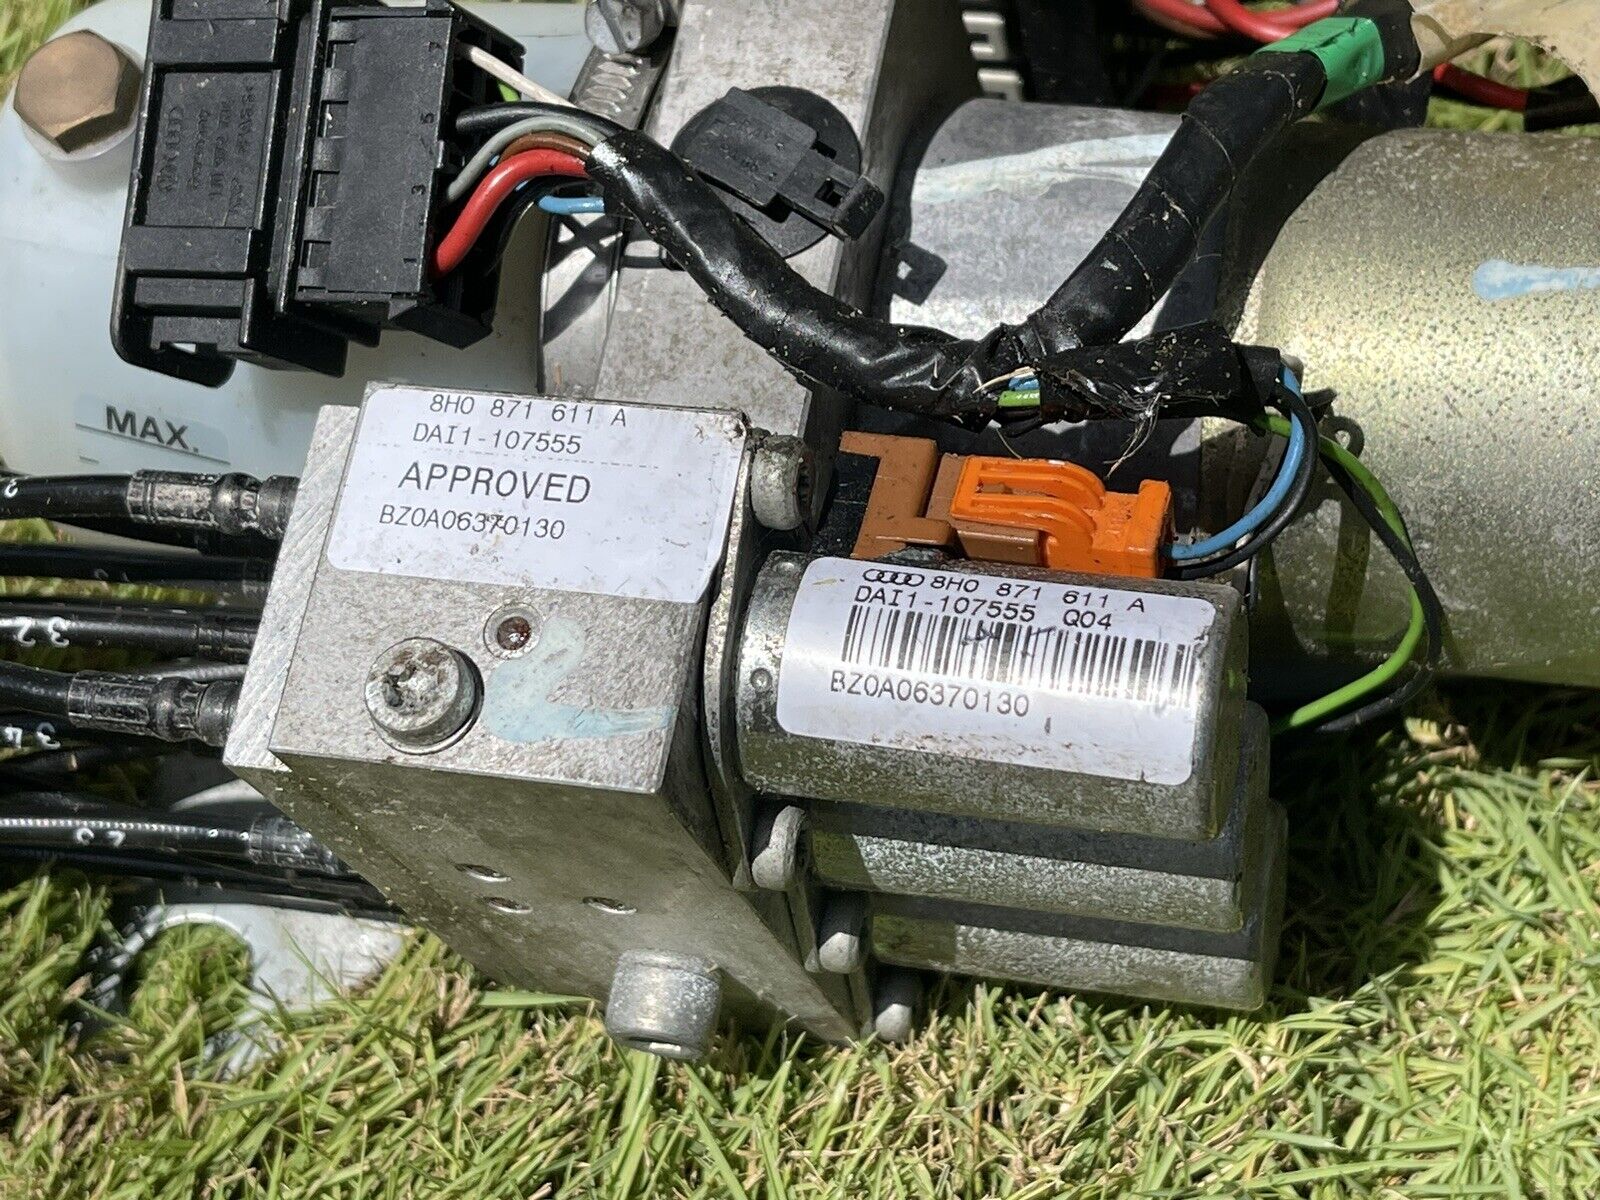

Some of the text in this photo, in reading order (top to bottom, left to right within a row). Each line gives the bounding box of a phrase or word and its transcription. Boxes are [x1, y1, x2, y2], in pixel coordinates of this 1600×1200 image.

[105, 405, 199, 453] MAX.
[490, 398, 532, 420] 871
[551, 403, 594, 425] 611
[610, 408, 627, 427] A
[412, 422, 582, 455] DAI1-107555
[398, 461, 591, 504] APPROVED
[854, 585, 1036, 622] DAI1-107555
[996, 582, 1042, 599] 871
[1063, 589, 1110, 605] 611
[1127, 599, 1145, 613] A
